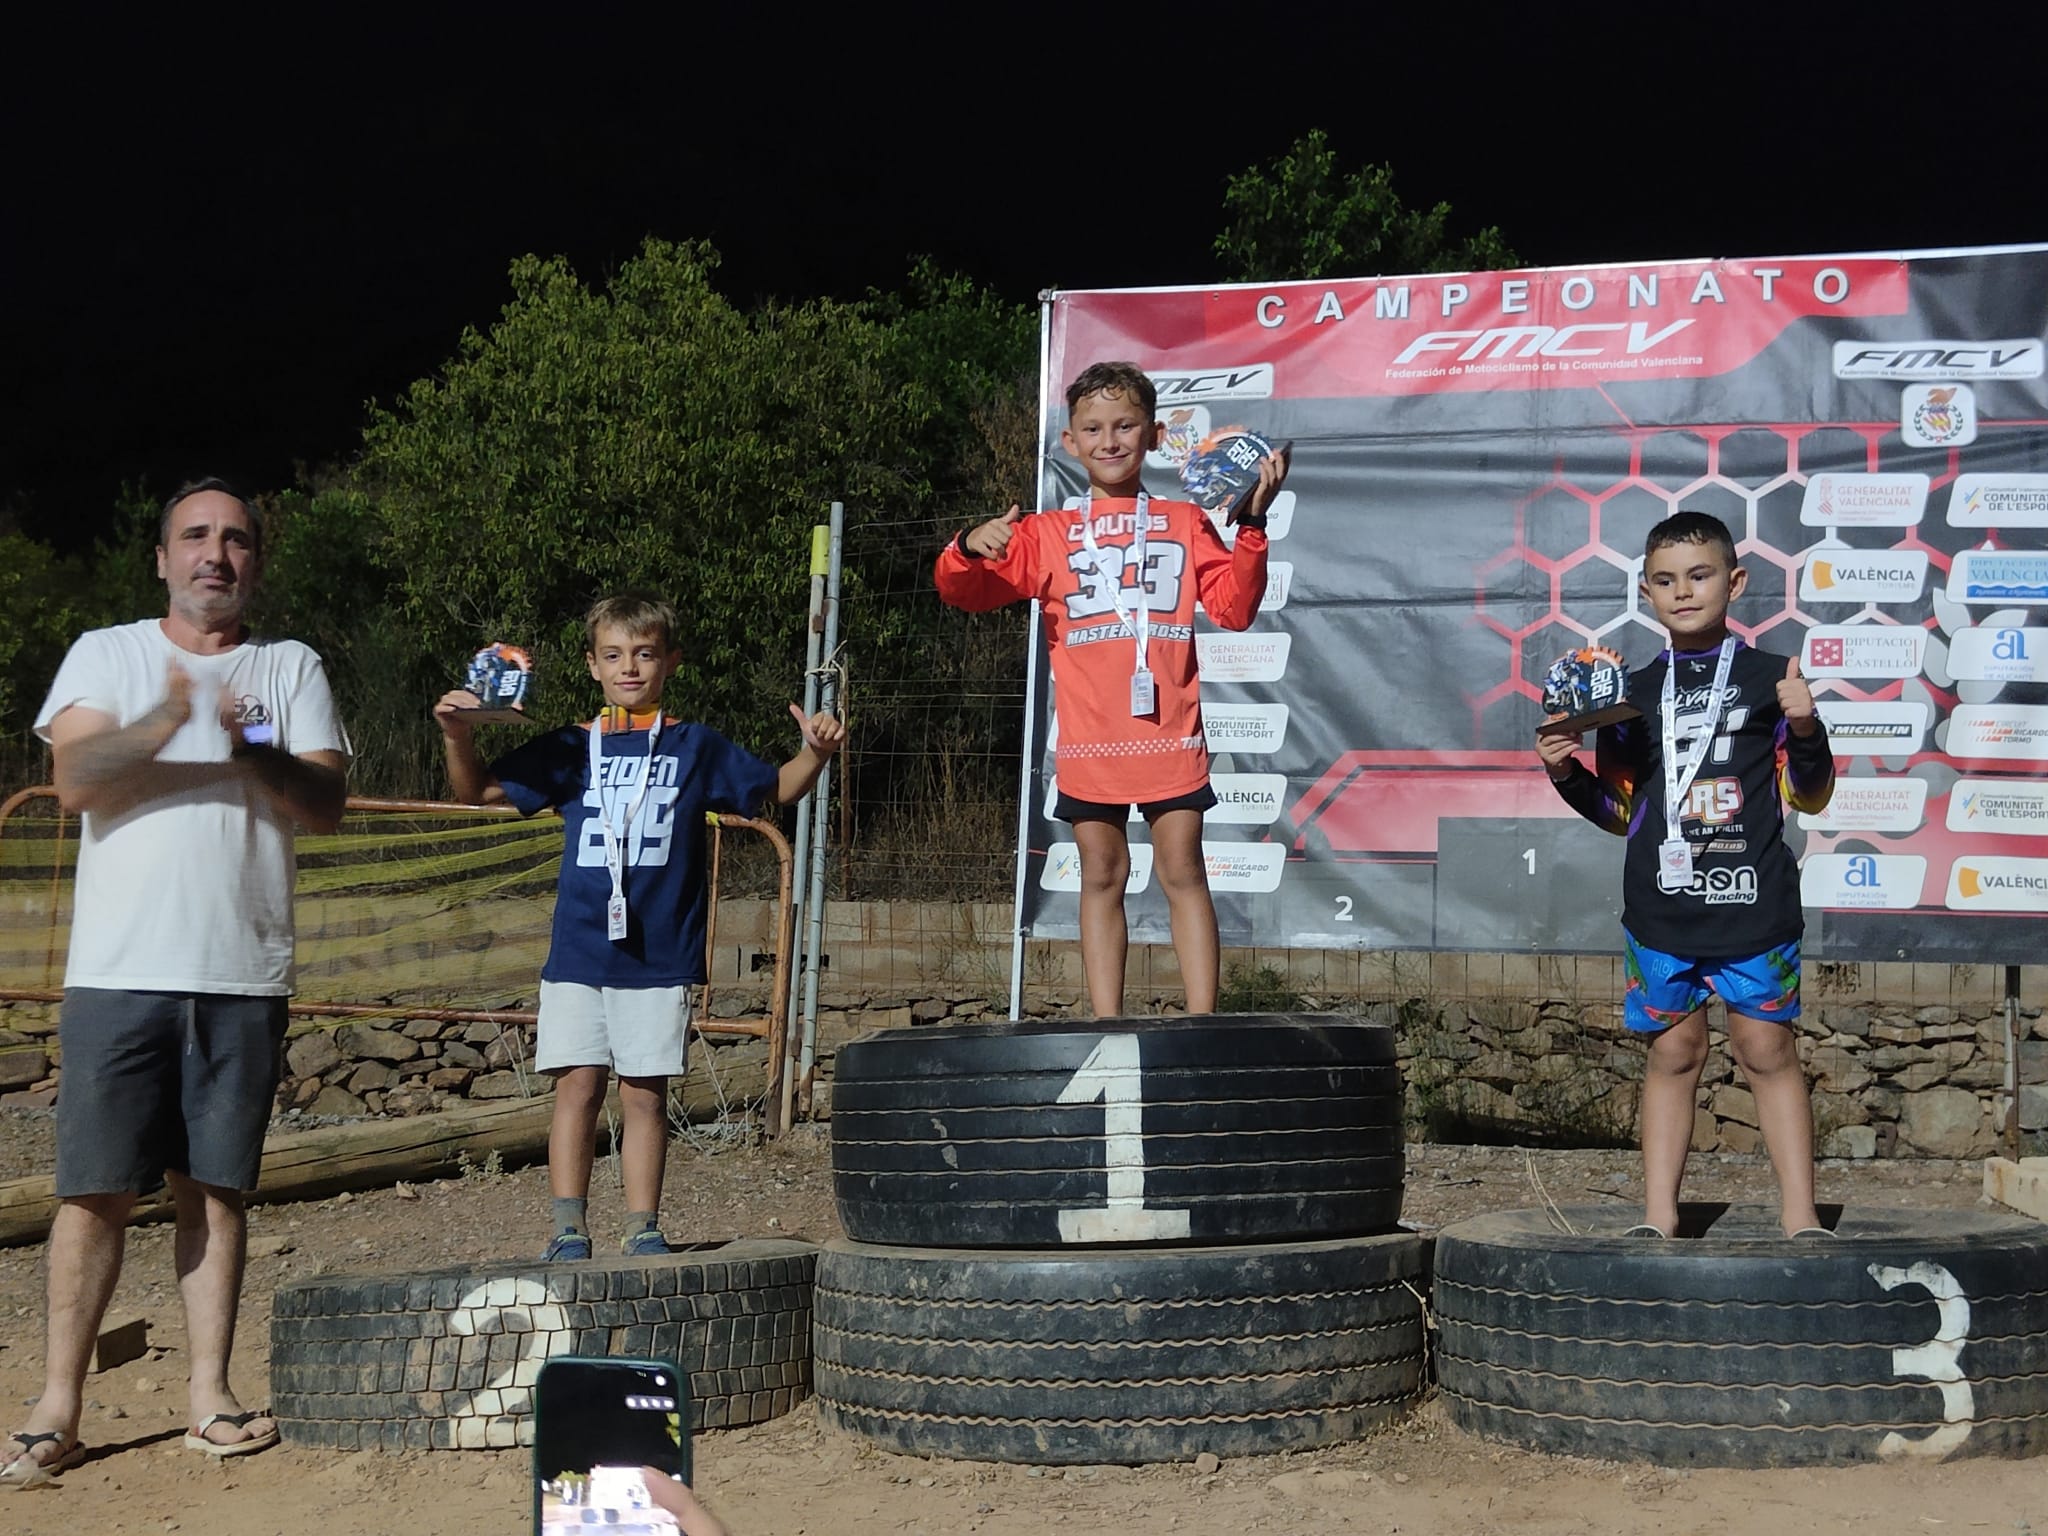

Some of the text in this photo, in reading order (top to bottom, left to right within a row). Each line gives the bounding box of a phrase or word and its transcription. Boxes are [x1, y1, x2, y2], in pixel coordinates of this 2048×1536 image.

[1256, 268, 1849, 329] CAMPEONATO
[1392, 318, 1697, 365] FMCV
[1845, 347, 2033, 368] FMCV
[1385, 355, 1703, 379] Federación de Motociclismo de la Comunidad Valenciana
[1153, 370, 1264, 394] MCV
[1838, 486, 1912, 495] GENERALITAT
[1839, 497, 1911, 506] VALENCIANA
[1989, 502, 2004, 511] DE
[1837, 566, 1915, 581] VALÈNCIA
[1065, 622, 1193, 648] MASTERROSS
[1209, 645, 1277, 654] GENERALITAT
[1210, 655, 1275, 664] VALENCIANA
[1590, 667, 1613, 687] 20
[1590, 681, 1613, 700] 26
[1661, 685, 1740, 710] LVAO
[1205, 721, 1267, 730] COMUNITAT
[1834, 725, 1910, 735] MICHELIN
[1210, 730, 1275, 739] DE L'ESPORT
[1216, 789, 1275, 804] ALÈNCIA
[1835, 791, 1911, 800] GENERALITAT
[1835, 802, 1909, 811] VALENCIANA
[1980, 800, 2044, 810] COMUNITAT
[1985, 809, 1998, 818] DE
[1232, 863, 1269, 872] RICARDO
[1522, 848, 1536, 875] 1
[1222, 870, 1251, 878] TORMO
[1984, 874, 2048, 889] VALÈNCI
[1706, 891, 1756, 903] Racing
[1334, 895, 1353, 921] 2
[1056, 1033, 1190, 1243] 1
[449, 1277, 571, 1448] 2
[1867, 1260, 1975, 1464] 3
